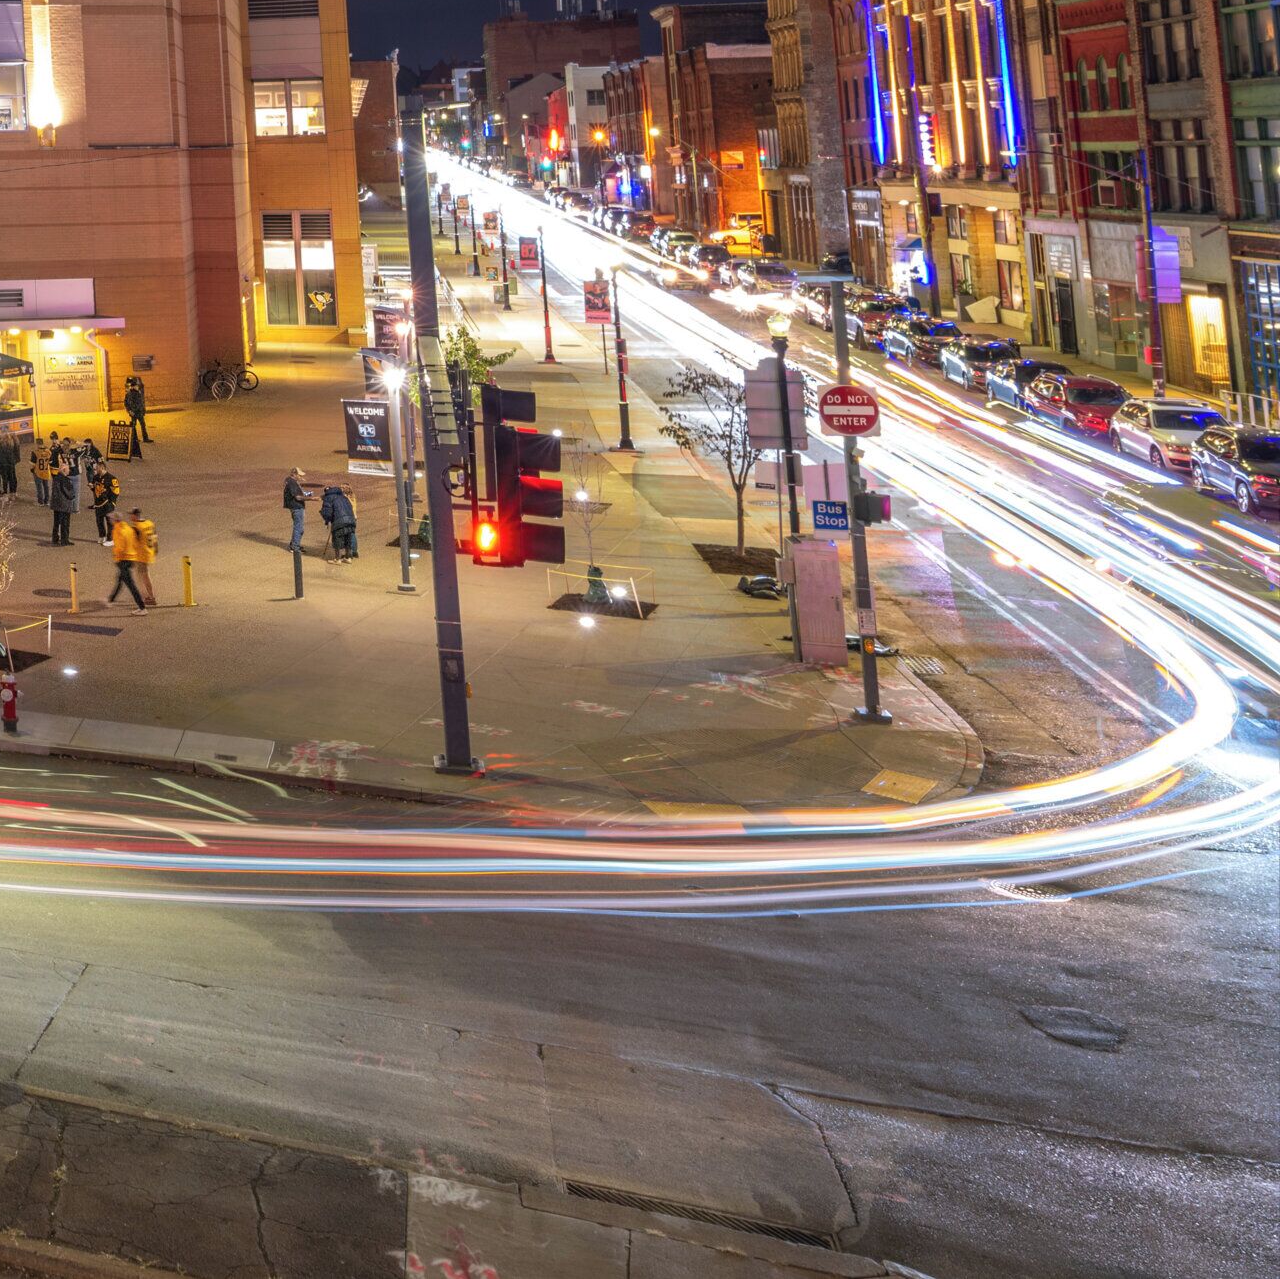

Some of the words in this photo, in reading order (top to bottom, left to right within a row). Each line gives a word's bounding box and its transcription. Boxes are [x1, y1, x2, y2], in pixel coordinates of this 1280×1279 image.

[827, 395, 841, 404] DO
[847, 395, 869, 404] NOT
[347, 407, 385, 416] WELCOME
[833, 417, 867, 426] ENTER
[356, 444, 382, 453] ARENA
[817, 503, 843, 514] Bus
[815, 514, 847, 527] Stop
